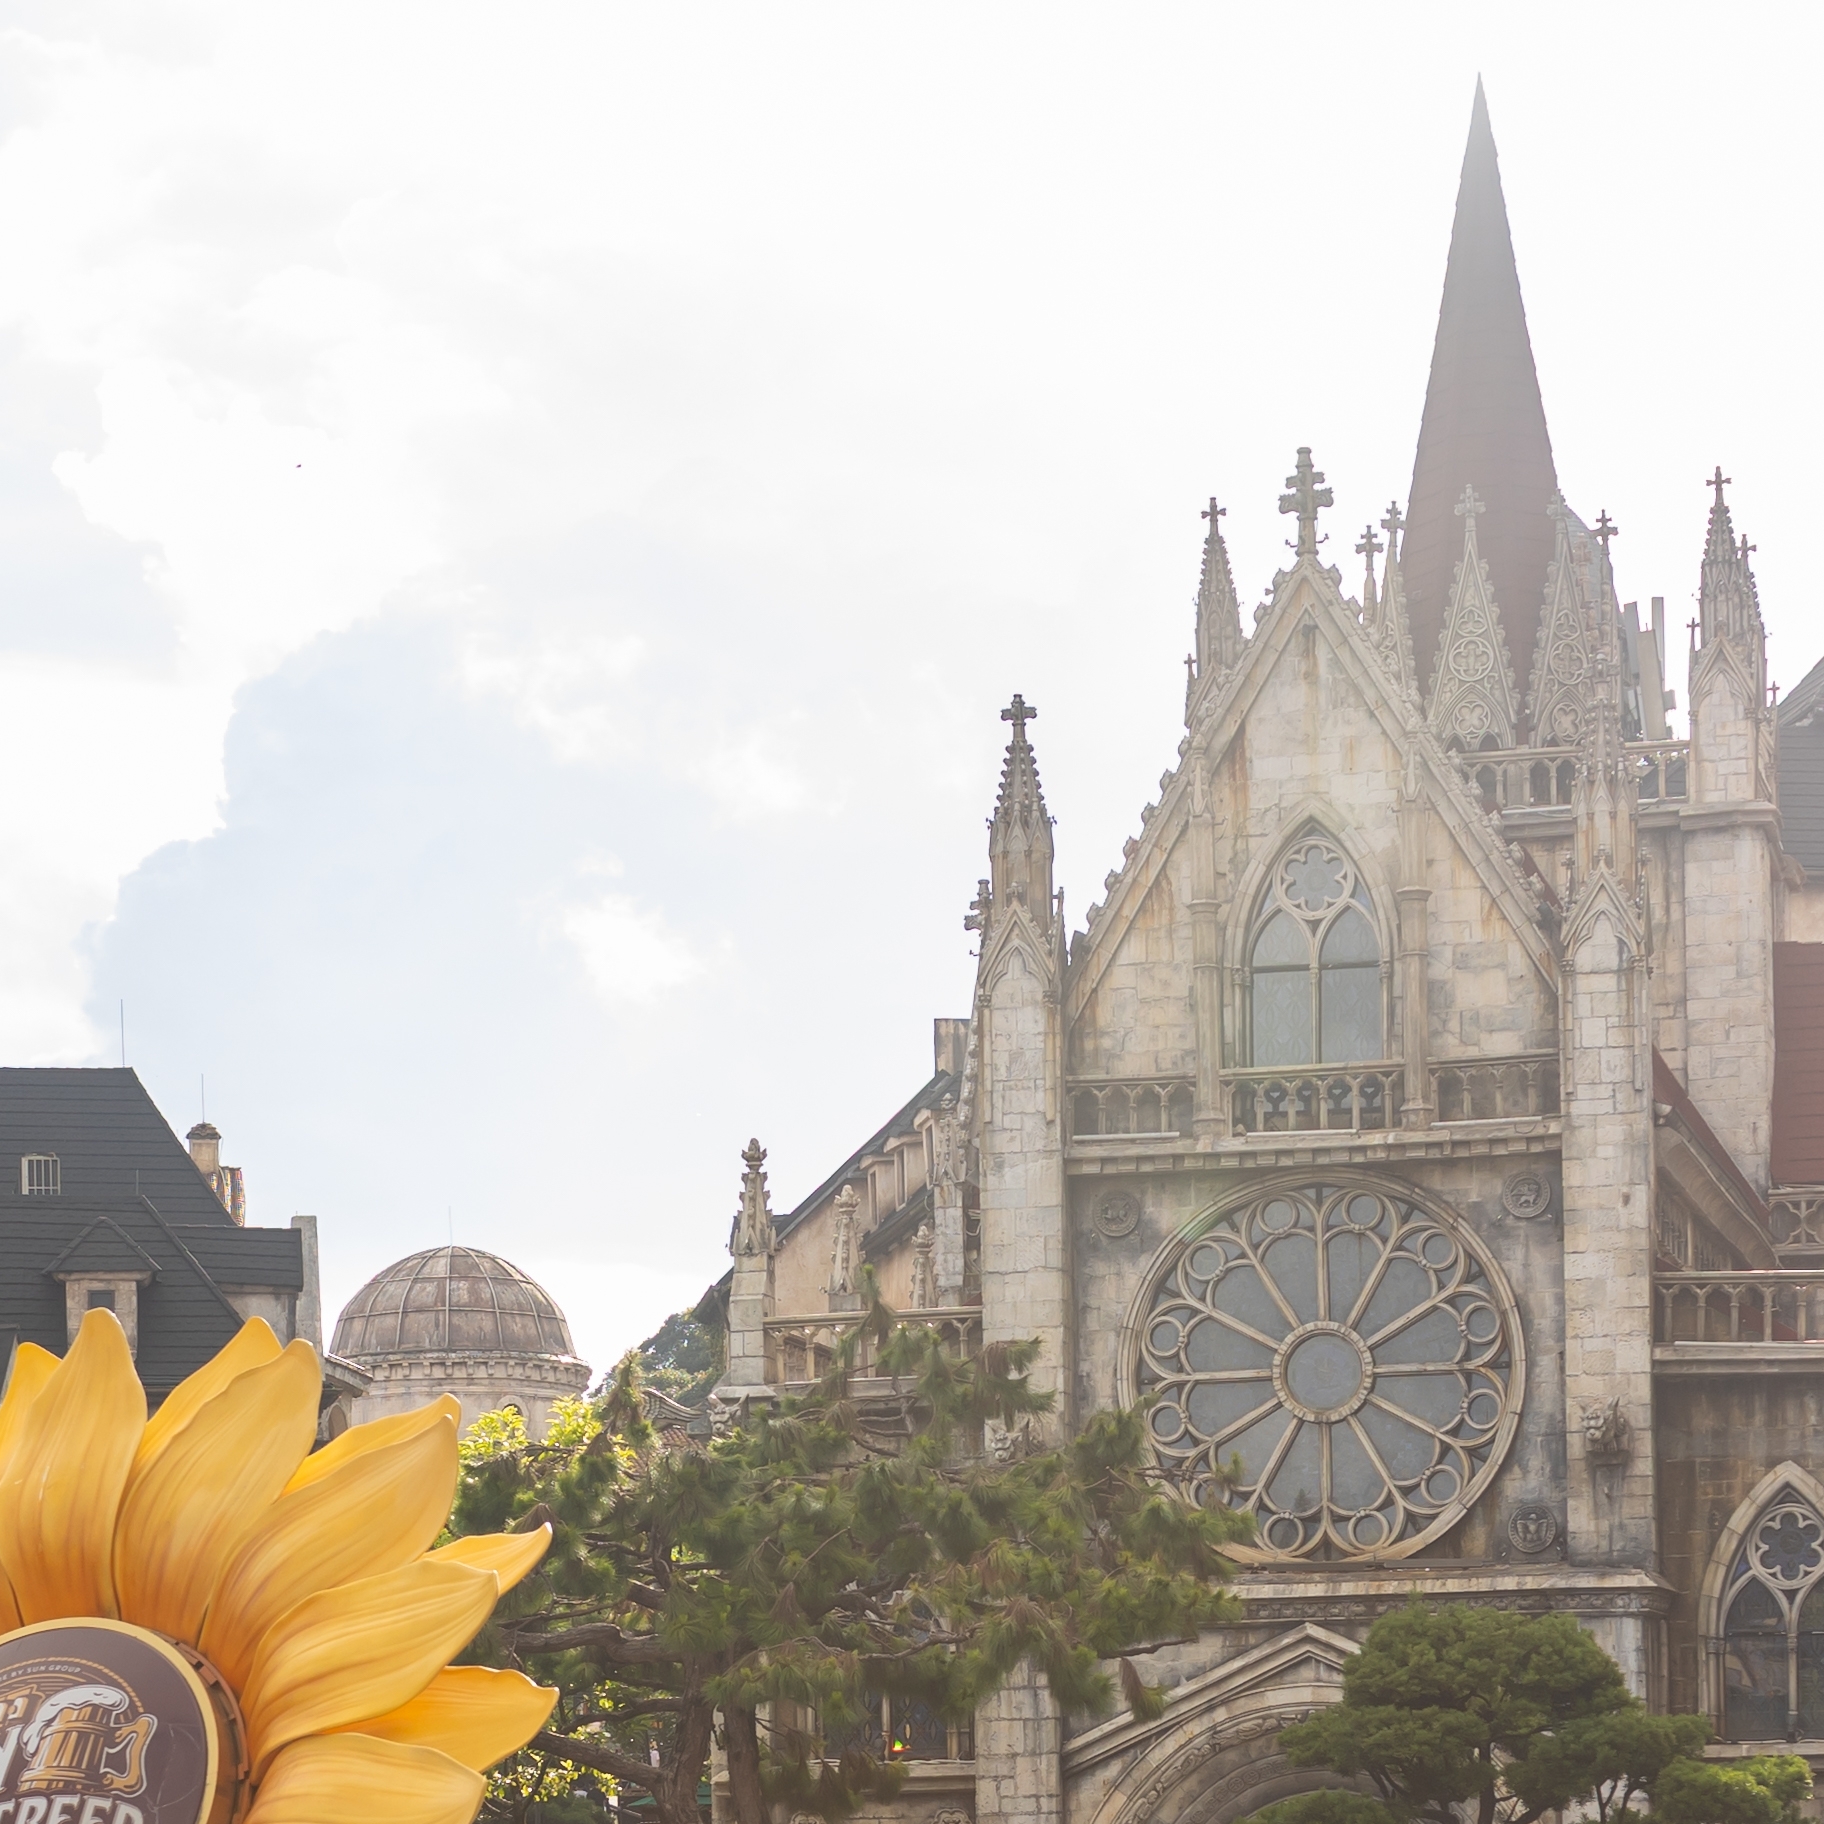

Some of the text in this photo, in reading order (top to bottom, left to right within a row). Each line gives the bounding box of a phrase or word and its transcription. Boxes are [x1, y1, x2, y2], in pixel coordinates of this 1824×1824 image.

[10, 1668, 25, 1678] BY
[26, 1665, 47, 1674] SUN
[48, 1664, 82, 1673] GROUP
